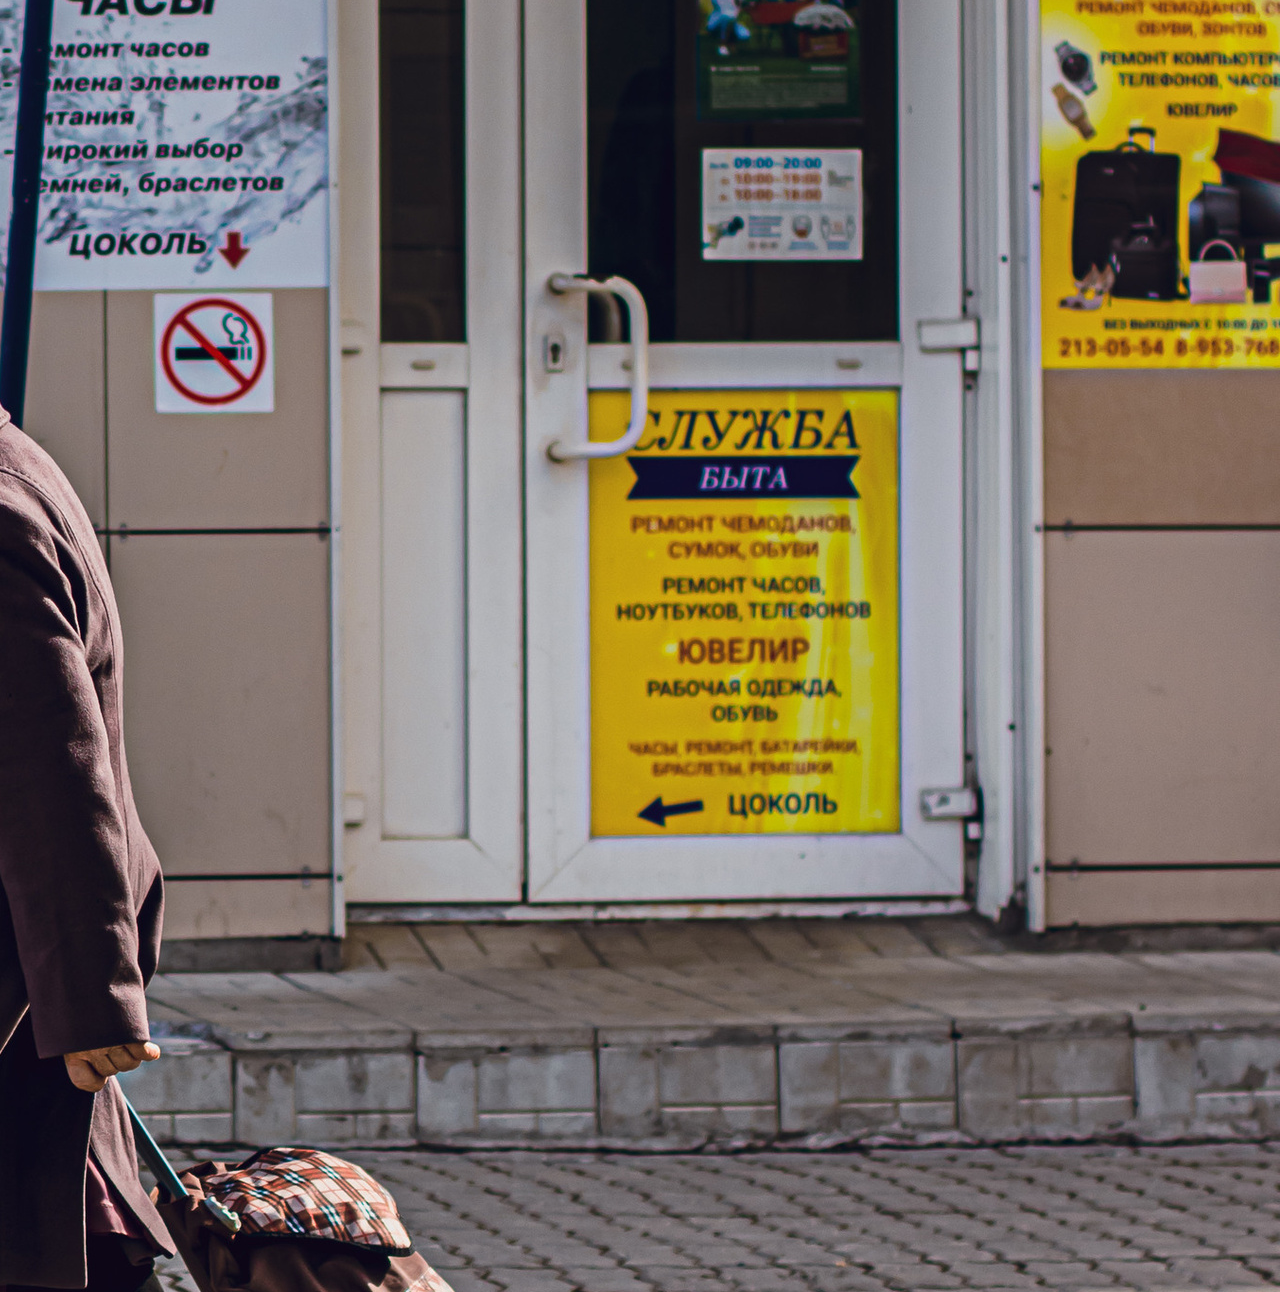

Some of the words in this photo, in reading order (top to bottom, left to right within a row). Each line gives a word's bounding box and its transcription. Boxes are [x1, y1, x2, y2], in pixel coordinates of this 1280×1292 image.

[129, 41, 210, 58] часов
[1100, 51, 1167, 66] РЕМОНТ
[128, 73, 282, 91] элементов
[1166, 102, 1238, 118] ЮВЕЛИР
[45, 139, 148, 164] ирокий
[154, 137, 243, 162] выбор
[138, 174, 284, 196] браслетов
[68, 231, 208, 259] ЦОКОЛЬ
[700, 467, 788, 490] БЫТА
[630, 515, 715, 533] РЕМОНТ
[750, 541, 819, 558] ОБУВИ
[663, 577, 746, 594] РЕМОНТ
[752, 577, 826, 596] ЧАСОВ,
[617, 602, 743, 623] НОУТБУКОВ,
[749, 601, 871, 619] ТЕЛЕФОНОВ
[677, 637, 810, 664] ЮВЕЛИР
[647, 679, 741, 697] РАБОЧАЯ
[747, 679, 841, 698] ОДЕЖДА,
[711, 705, 778, 723] ОБУВЬ
[728, 792, 838, 819] ЦОКОЛЬ
